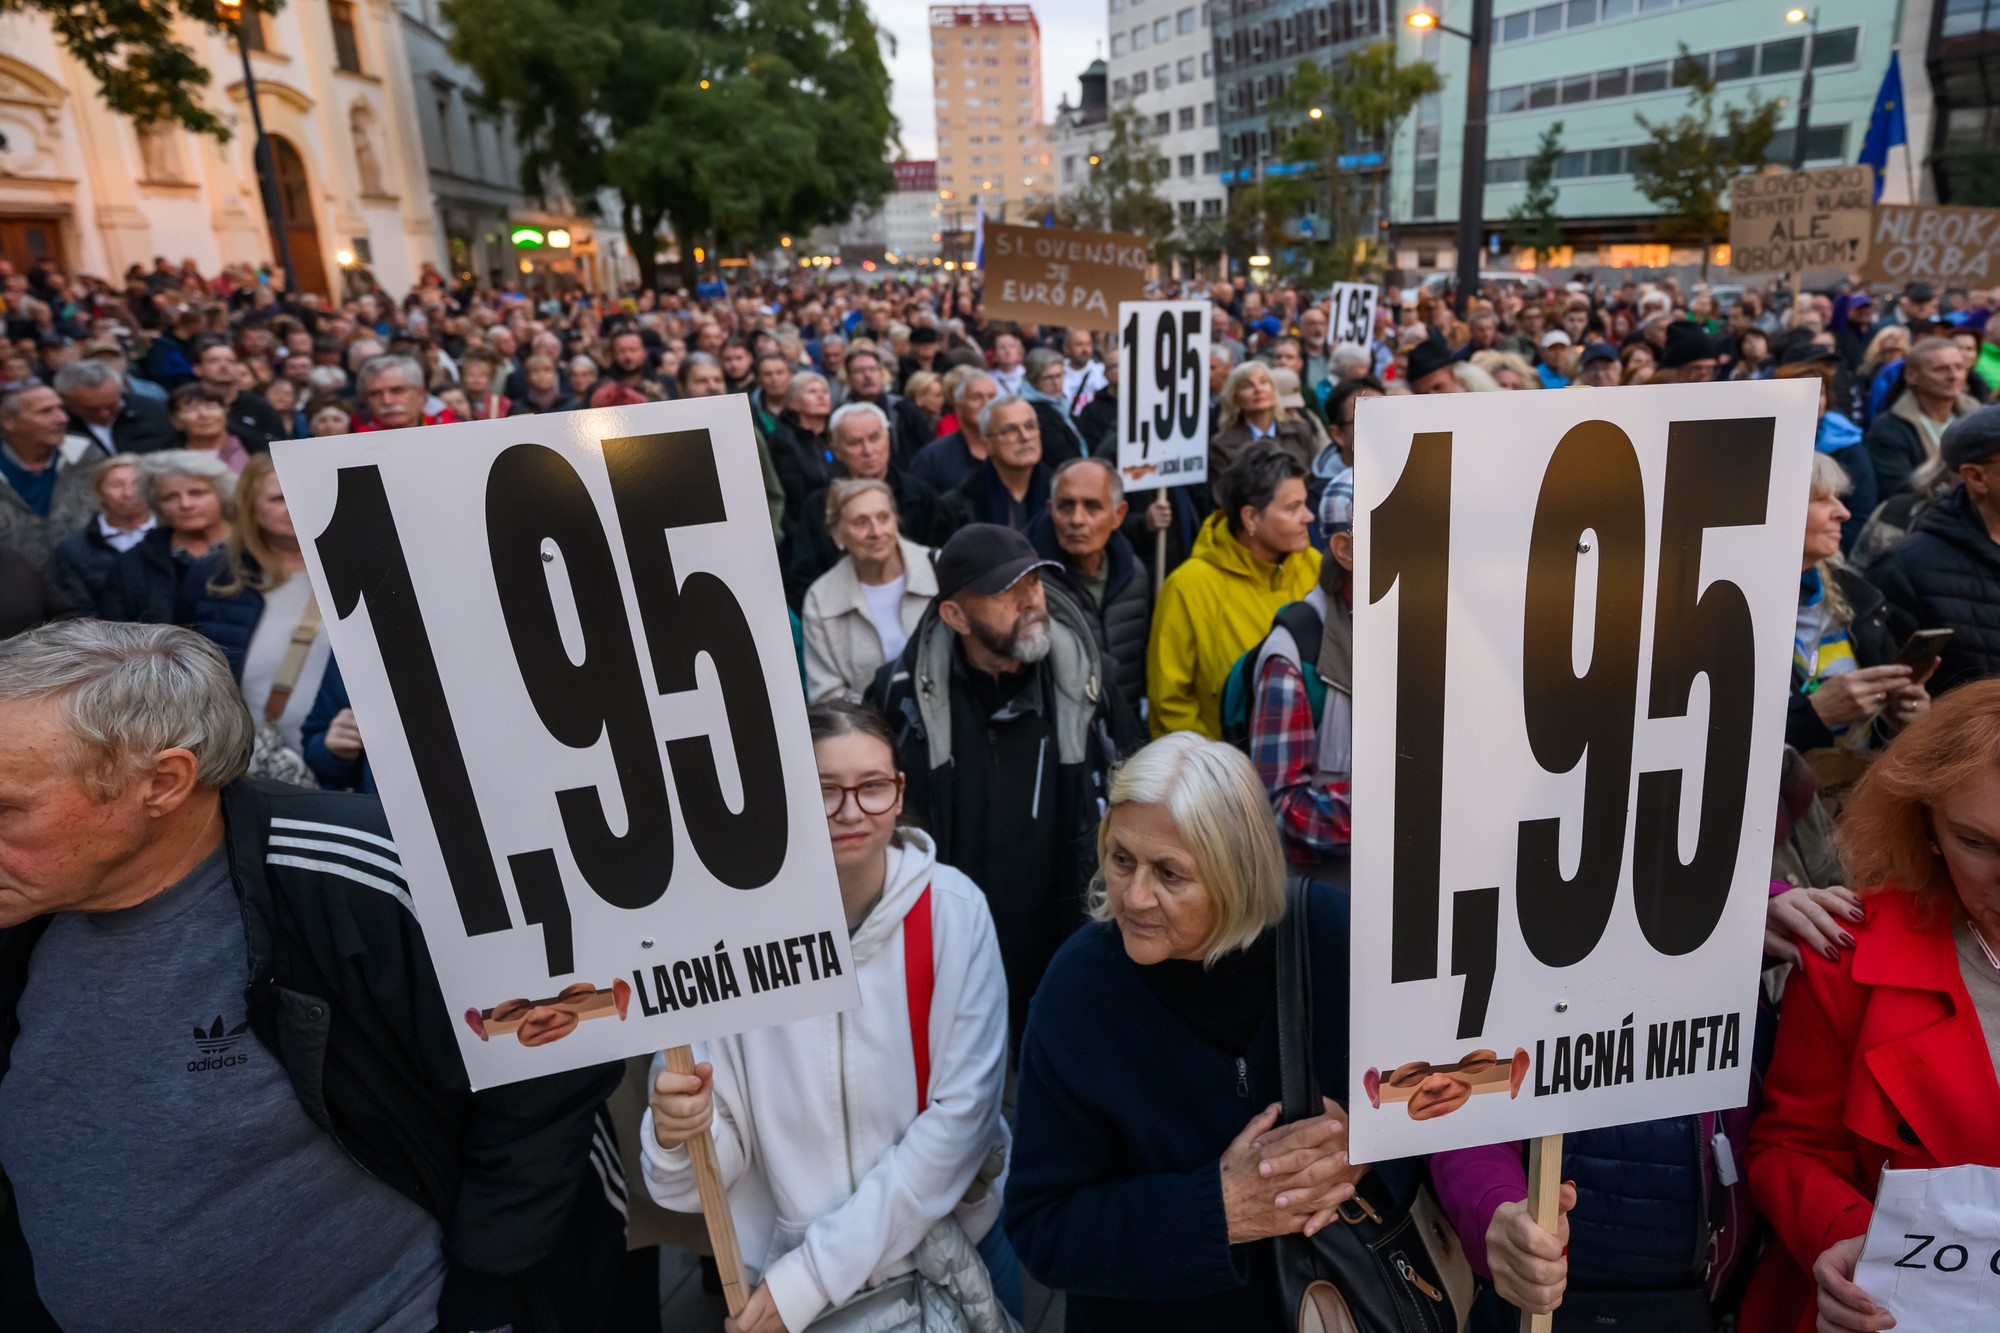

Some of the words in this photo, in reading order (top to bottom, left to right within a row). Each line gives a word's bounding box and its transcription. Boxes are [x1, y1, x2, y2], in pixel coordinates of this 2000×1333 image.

[1735, 168, 1863, 199] SLOVENSKO
[1770, 213, 1832, 242] ALE
[995, 232, 1148, 271] SLOVENSKO
[1046, 262, 1070, 281] JE
[1881, 244, 1990, 278] ORBA
[1002, 278, 1110, 319] EURÓPA
[1123, 310, 1204, 459] 1,95
[313, 428, 788, 978] 1,95
[1369, 417, 1777, 1040] 1,95
[632, 939, 742, 1018] LACNÁ
[742, 930, 843, 994] NAFTA
[186, 1053, 249, 1073] adidas
[1534, 1011, 1634, 1098] LACNÁ
[1645, 1012, 1740, 1081] NAFTA
